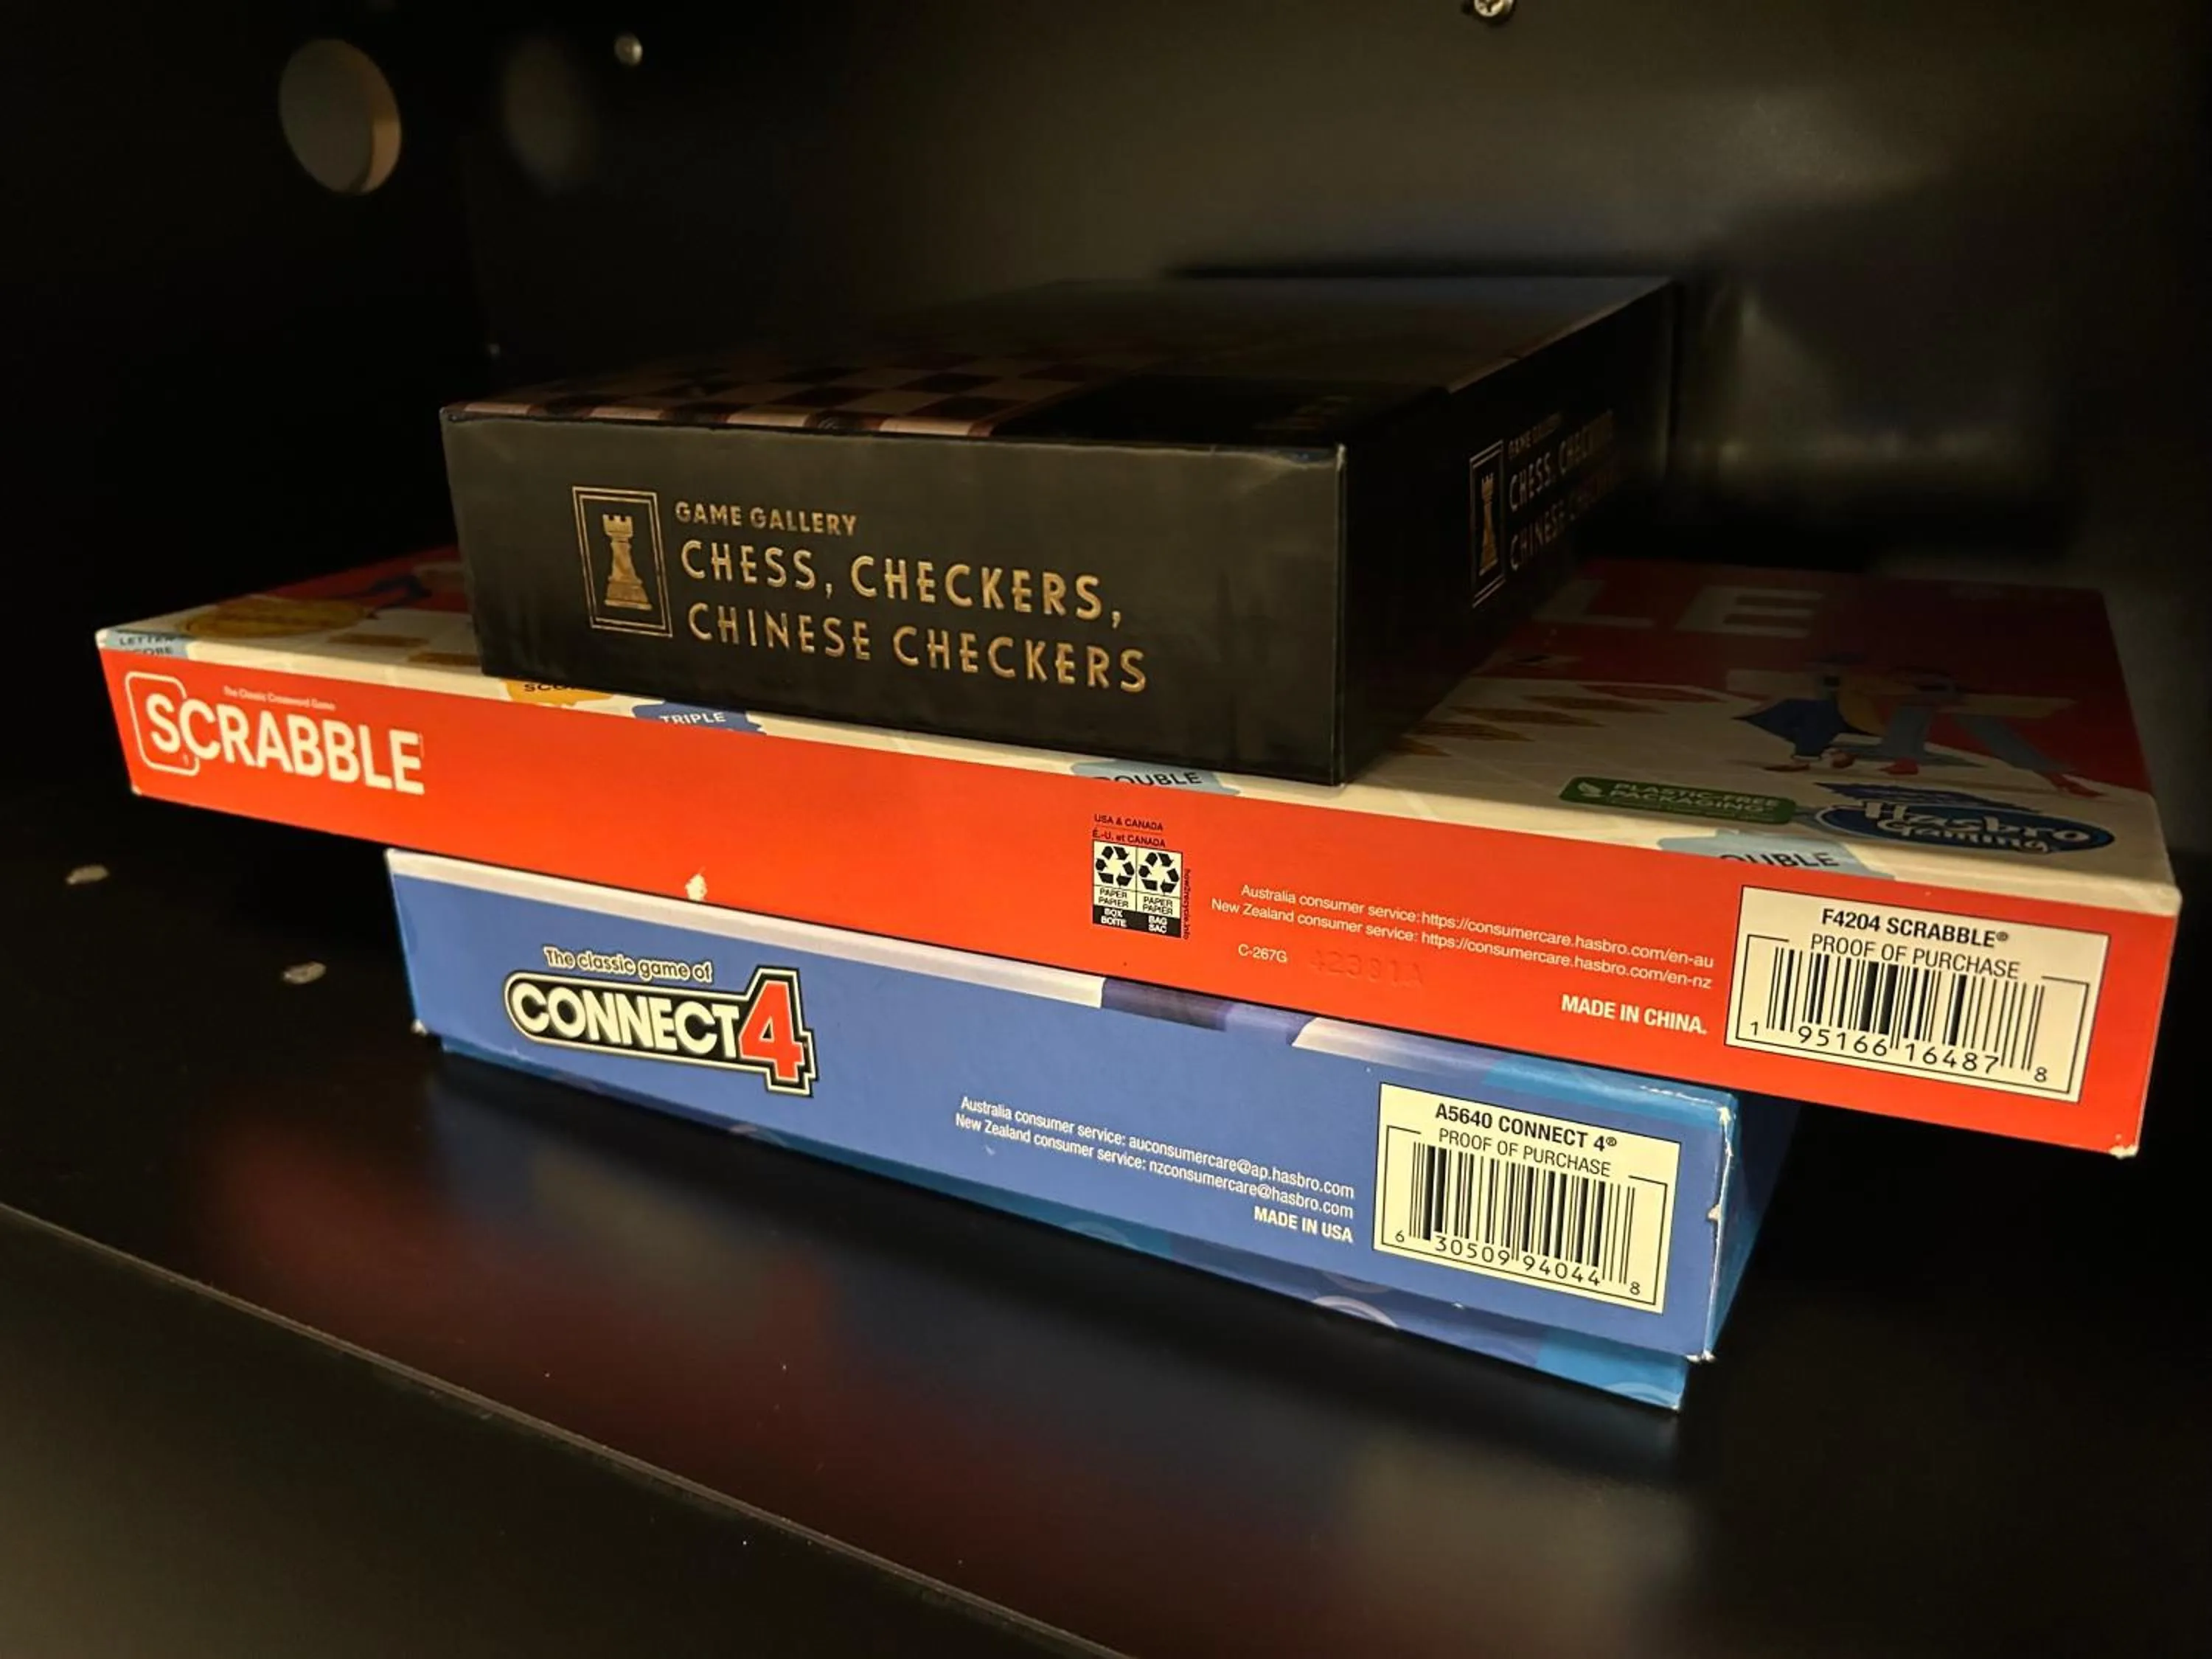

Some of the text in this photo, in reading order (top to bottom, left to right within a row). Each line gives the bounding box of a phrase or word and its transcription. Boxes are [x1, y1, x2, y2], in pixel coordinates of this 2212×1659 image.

[675, 501, 857, 536] GAME GALLERY
[681, 541, 1122, 628] CHESS, CHECKERS,
[688, 602, 1147, 693] CHINESE CHECKERS
[147, 693, 425, 795] SCRABBLE
[1093, 772, 1203, 786] OUBLE
[1094, 814, 1164, 831] USA & CANADA
[1116, 834, 1125, 842] et
[1127, 835, 1166, 847] CANADA
[1863, 801, 2091, 843] Hasbro
[1098, 897, 1129, 908] PAPIER
[1099, 888, 1127, 899] PAPER
[1142, 904, 1173, 915] PAPIER
[1144, 896, 1173, 908] PAPER
[1241, 884, 1296, 904] Australia
[1298, 893, 1364, 914] consumer
[1104, 908, 1123, 918] BOX
[1148, 915, 1167, 925] BAG
[1821, 908, 1880, 933] F4204
[1211, 897, 1713, 989] New Zealand consumer service: https://consumercare.hasbro.com/en-nz
[1238, 944, 1287, 963] C-267G
[1810, 933, 2020, 980] PROOF OF PURCHASE
[544, 947, 714, 983] The classic game of
[511, 979, 804, 1081] CONNECT 4
[1561, 994, 1708, 1034] MADE IN CHINA.
[1750, 1020, 2048, 1083] 1 95166 16487 8
[1436, 1103, 1492, 1129] A5640
[1498, 1116, 1587, 1149] CONNECT
[956, 1113, 1354, 1219] New Zealand consumer service: nzconsumercare@hasbro.com
[961, 1096, 1355, 1199] Australia consumer service: auconsumercare@ap.hasbro.com
[1439, 1127, 1611, 1178] PROOF OF PURCHASE
[1254, 1206, 1354, 1243] MADE IN USA
[1394, 1229, 1641, 1295] 6 30509 94044 8
